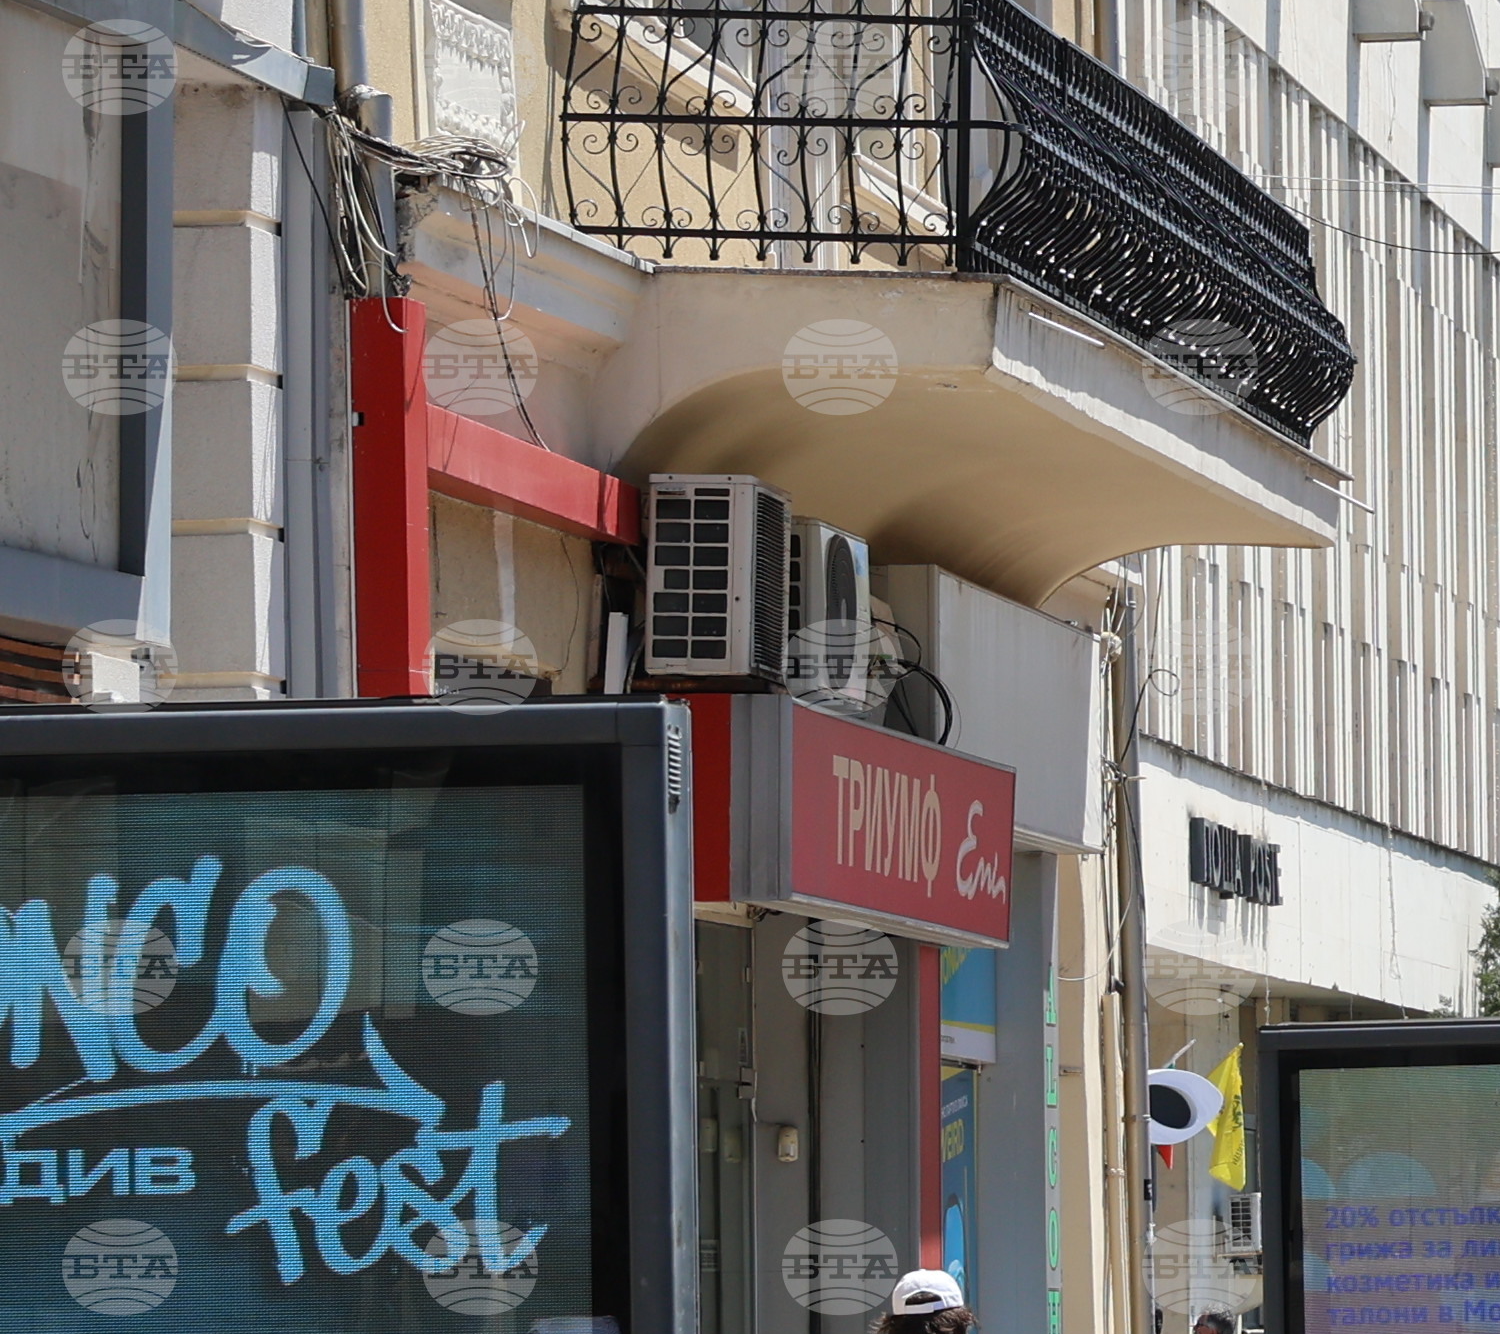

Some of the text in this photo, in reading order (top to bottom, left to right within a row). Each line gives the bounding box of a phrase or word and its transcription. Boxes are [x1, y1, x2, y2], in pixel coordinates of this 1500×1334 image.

[833, 754, 941, 898] ТРИУМФ
[0, 855, 355, 1083] NCO
[225, 1079, 572, 1284] fest
[1325, 1205, 1380, 1229] 20%
[1325, 1241, 1413, 1266] грижа
[1423, 1240, 1452, 1259] за
[1327, 1272, 1474, 1294] козметика
[1327, 1306, 1429, 1326] талони
[1439, 1304, 1453, 1323] в
